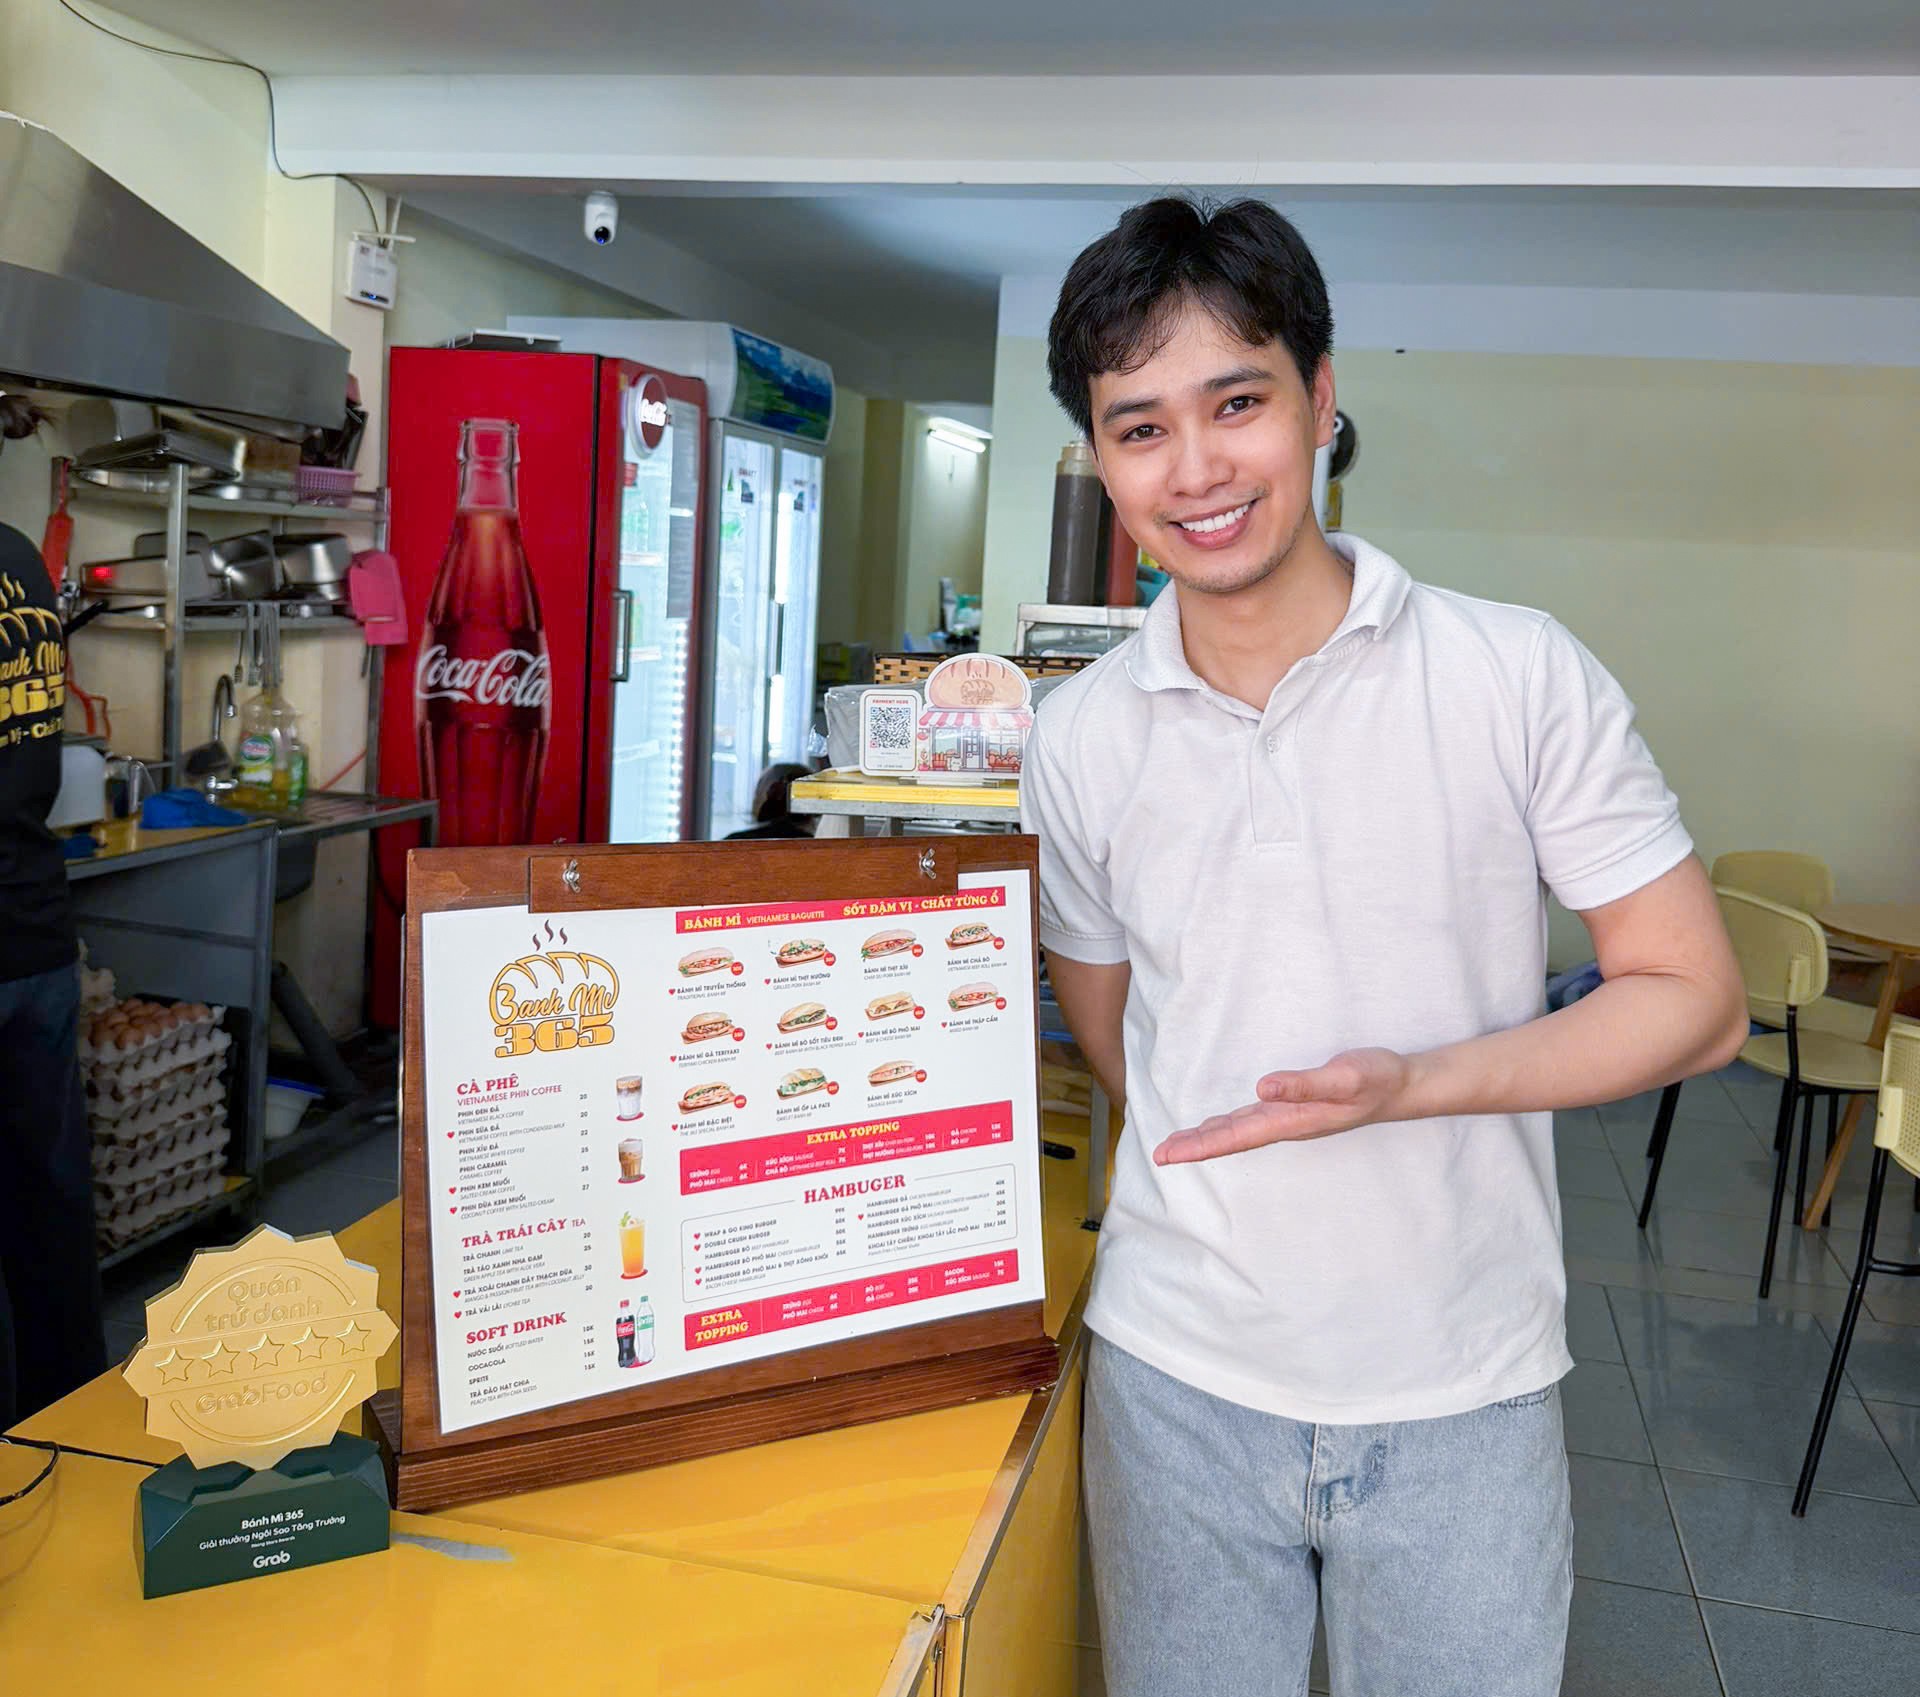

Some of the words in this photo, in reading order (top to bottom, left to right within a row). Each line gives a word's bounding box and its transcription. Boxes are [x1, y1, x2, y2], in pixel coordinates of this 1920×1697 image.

[843, 903, 866, 916] SỐT
[869, 901, 896, 915] ĐẬM
[898, 900, 912, 912] VỊ
[920, 895, 953, 909] CHẤT
[954, 893, 988, 907] TỪNG
[684, 916, 722, 930] BÁNH
[725, 913, 741, 926] MÌ
[746, 913, 789, 924] VIETNAMESE
[790, 910, 824, 920] BAGUETTE
[493, 1011, 615, 1058] 365
[456, 1078, 481, 1095] CÀ
[485, 1072, 519, 1091] PHÊ
[457, 1091, 507, 1106] VIETNAMESE
[509, 1089, 529, 1098] PHIN
[531, 1084, 562, 1095] COFFEE
[458, 1128, 474, 1136] PHIN
[806, 1128, 847, 1145] EXTRA
[849, 1120, 900, 1138] TOPPING
[458, 1147, 474, 1155] PHIN
[459, 1165, 475, 1173] PHIN
[476, 1159, 507, 1170] CARAMEL
[804, 1174, 906, 1204] HAMBUGER
[460, 1204, 476, 1212] PHIN
[493, 1198, 507, 1206] KEM
[461, 1230, 493, 1248] TRÀ
[496, 1223, 533, 1241] TRÁI
[536, 1218, 567, 1233] CÂY
[571, 1218, 586, 1227] TEA
[704, 1229, 721, 1237] WRAP
[738, 1223, 753, 1231] KING
[754, 1219, 776, 1228] BURGER
[704, 1239, 726, 1248] DOUBLE
[727, 1235, 747, 1244] CRUSH
[748, 1230, 770, 1240] BURGER
[476, 1249, 500, 1259] CHANH
[491, 1260, 510, 1269] XANH
[511, 1257, 526, 1265] NHA
[704, 1247, 740, 1260] HAMBURGER
[704, 1258, 740, 1271] HAMBURGER
[765, 1251, 776, 1259] MAI
[228, 1273, 301, 1305] Quán
[495, 1279, 520, 1289] CHANH
[253, 1296, 321, 1324] danh
[700, 1308, 742, 1326] EXTRA
[466, 1324, 508, 1344] SOFT
[513, 1311, 567, 1334] DRINK
[694, 1321, 749, 1342] TOPPING
[467, 1357, 506, 1372] COCACOLA
[468, 1374, 488, 1385] SPRITE
[513, 1378, 530, 1387] CHIA
[195, 1371, 328, 1414] GrabFood
[241, 1515, 269, 1530] Bánh
[271, 1512, 284, 1523] Mì
[285, 1509, 304, 1521] 365
[200, 1539, 218, 1550] Giải
[218, 1533, 250, 1547] thưởng
[251, 1528, 272, 1541] Ngôi
[273, 1525, 290, 1536] Sao
[292, 1522, 314, 1534] Tăng
[315, 1515, 346, 1528] Trưởng
[253, 1550, 291, 1569] Grab
